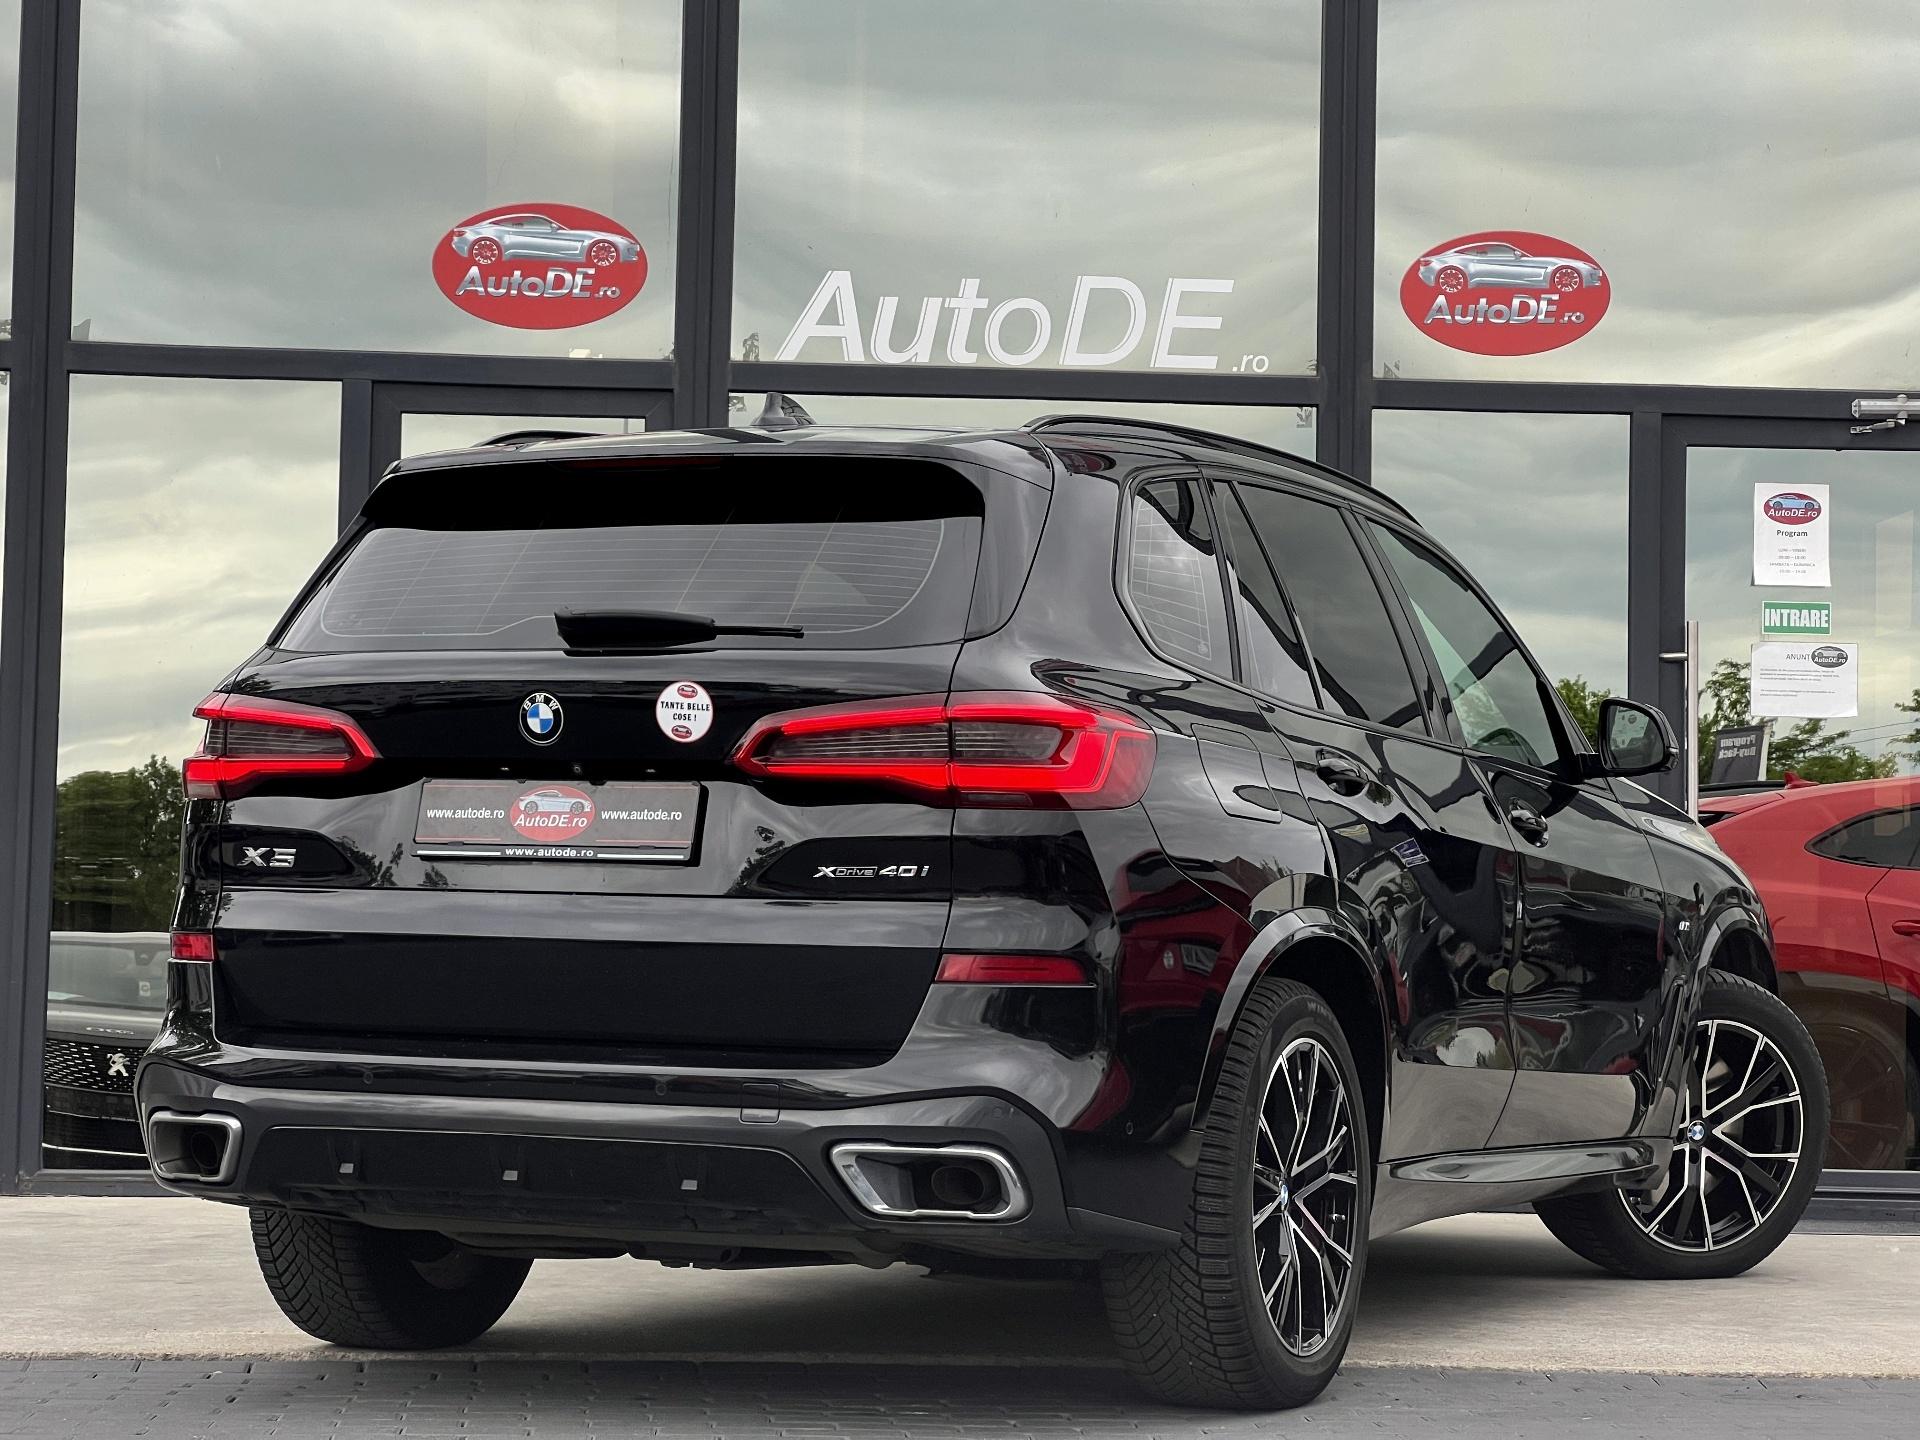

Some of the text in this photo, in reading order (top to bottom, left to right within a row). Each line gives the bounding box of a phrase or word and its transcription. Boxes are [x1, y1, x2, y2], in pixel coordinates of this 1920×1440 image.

[1767, 508, 1818, 518] AutoDE.ro
[1776, 529, 1808, 538] Program
[1764, 608, 1829, 628] INTRARE
[523, 694, 559, 711] BMW
[660, 700, 711, 712] TANTE BELLE
[672, 712, 692, 721] COSE
[426, 807, 504, 819] www.autode.ro
[601, 809, 682, 821] www.autode.ro
[514, 814, 588, 828] AutoDE.ro
[237, 846, 297, 868] X5
[505, 847, 594, 858] www.autode.ro
